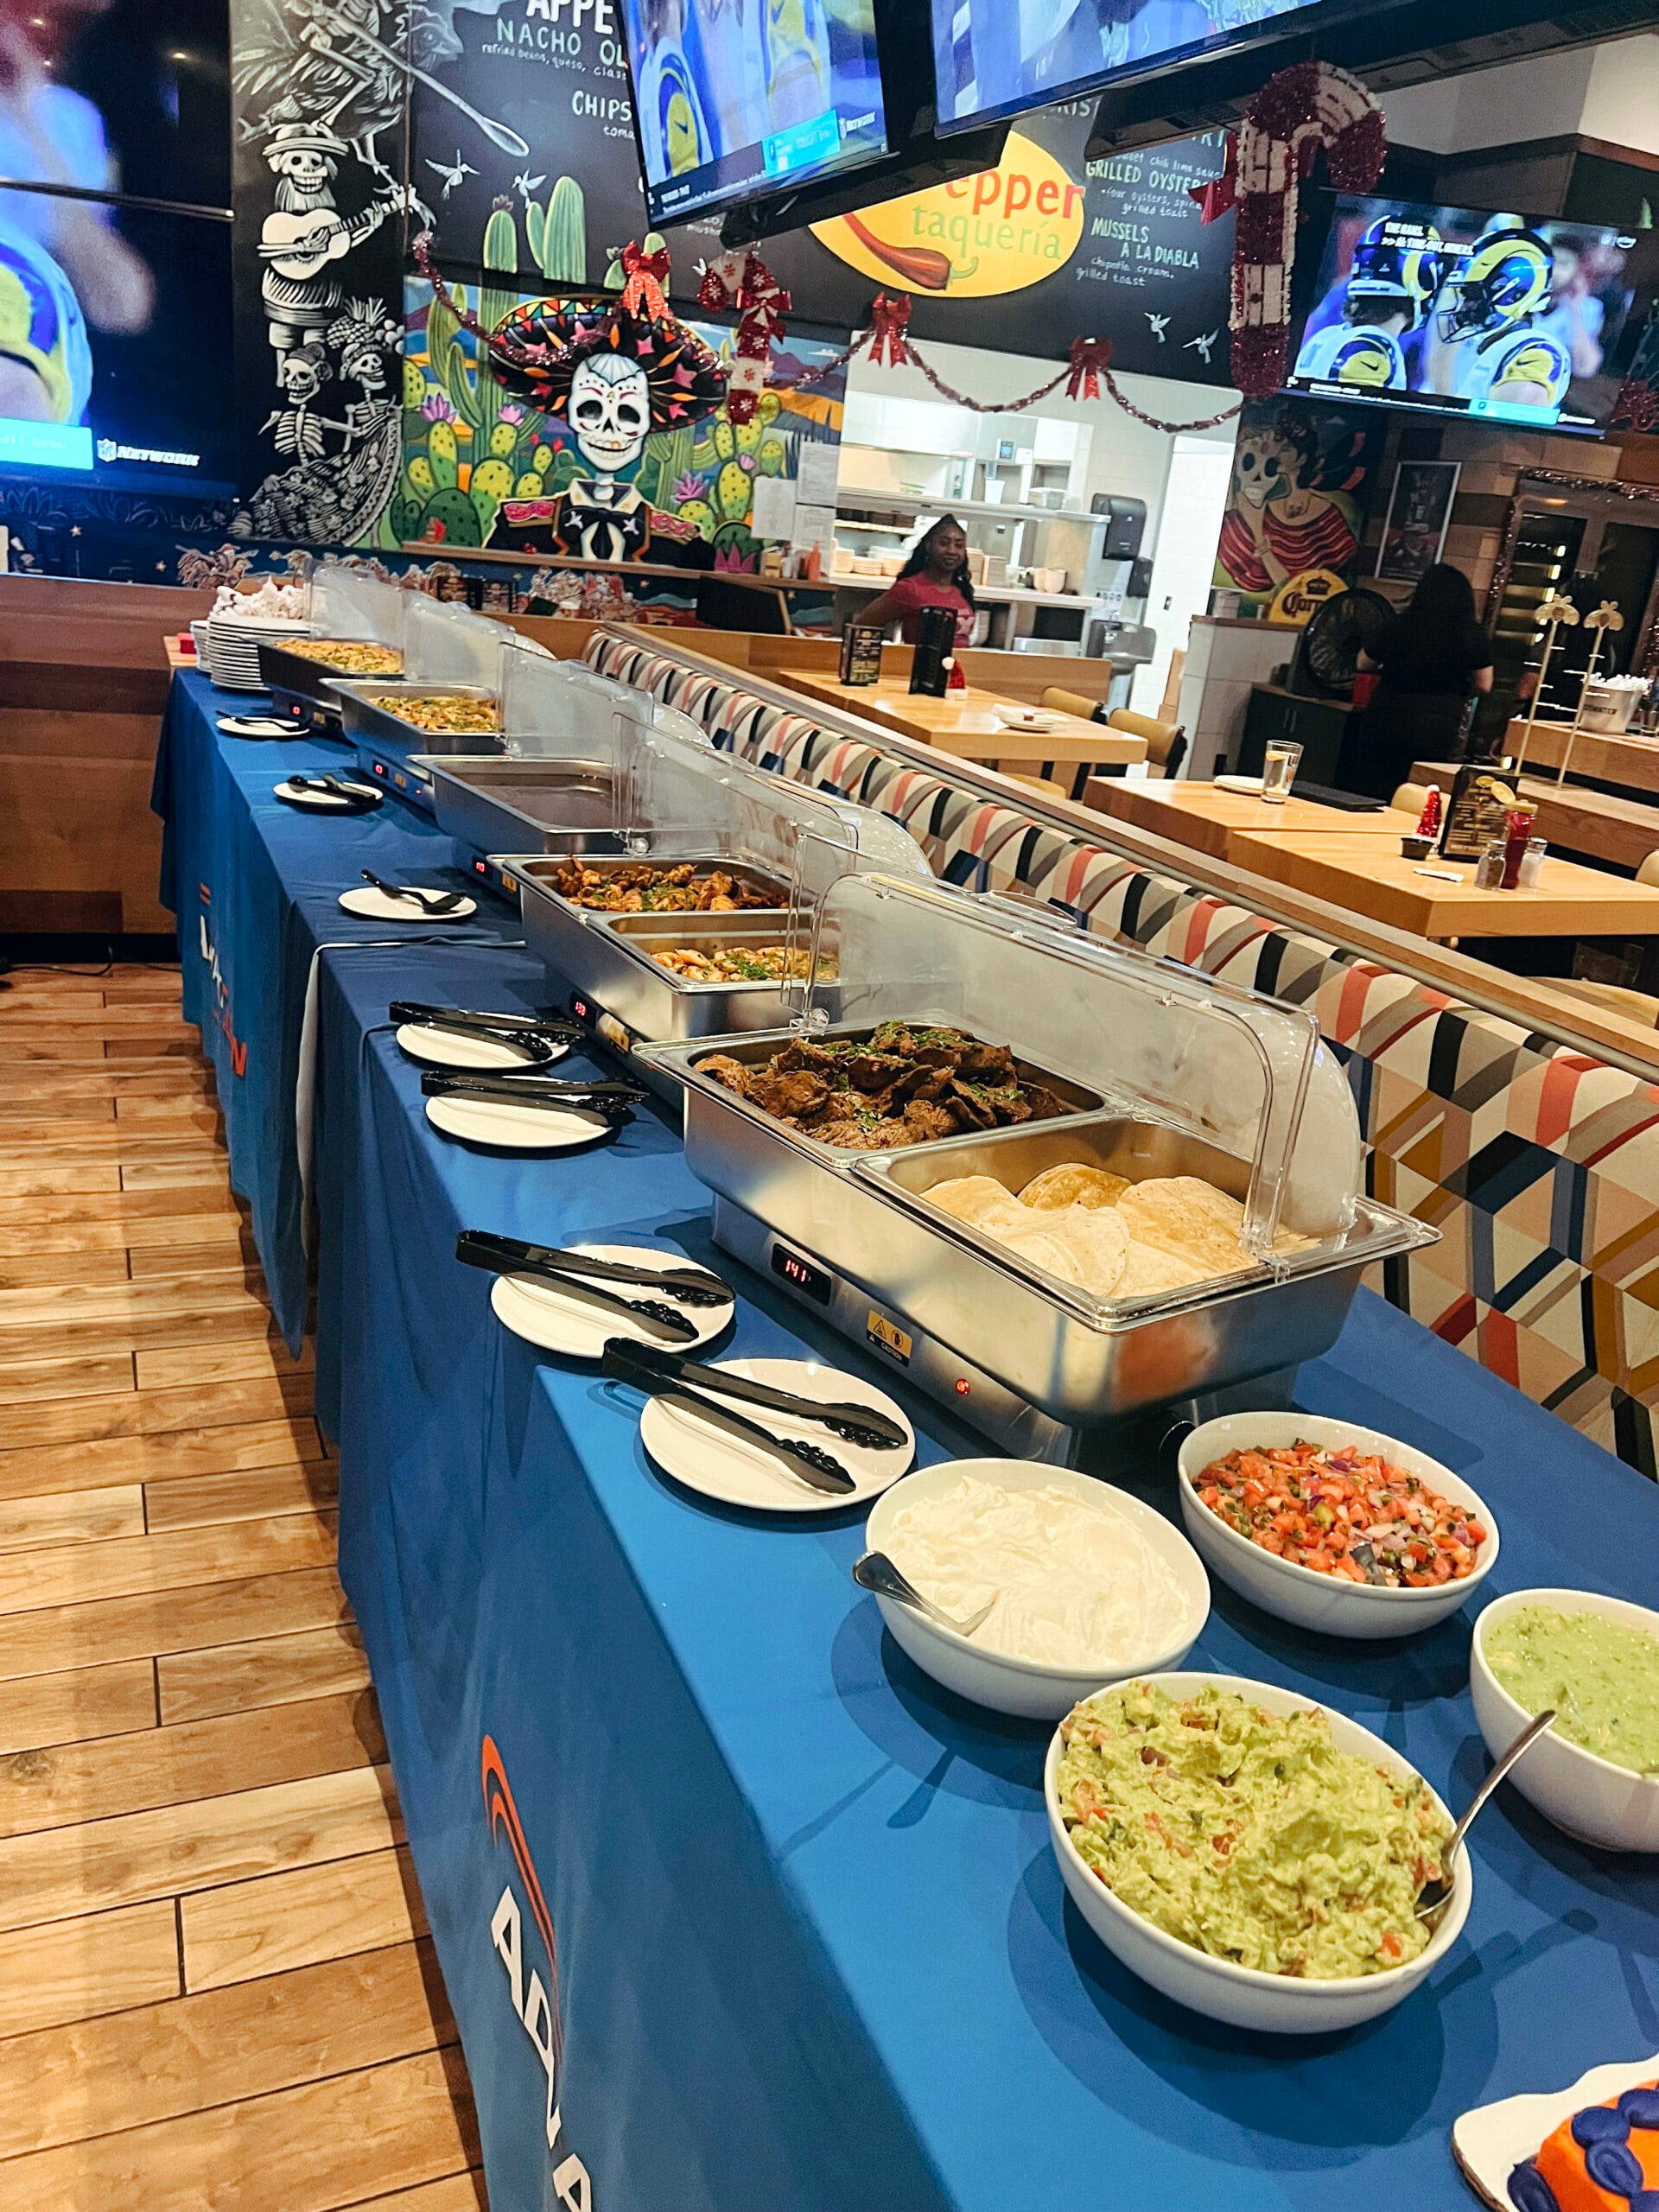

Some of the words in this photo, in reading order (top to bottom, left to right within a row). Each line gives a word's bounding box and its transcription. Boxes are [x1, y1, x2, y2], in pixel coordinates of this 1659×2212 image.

[497, 17, 582, 55] NACHO
[482, 44, 515, 57] refried
[518, 49, 550, 64] beans,
[552, 56, 586, 72] queso,
[571, 90, 632, 122] CHIPS
[1085, 161, 1141, 183] GRILLED
[1173, 161, 1192, 173] lime
[1122, 202, 1156, 215] grilled
[912, 205, 1061, 259] taquería
[1090, 218, 1150, 243] MUSSELS
[1091, 256, 1130, 271] chipotle
[1121, 242, 1130, 257] A
[1136, 244, 1152, 260] LA
[1154, 245, 1199, 270] DIABLA
[1076, 267, 1108, 281] grilled
[1113, 275, 1146, 286] toast
[785, 1260, 807, 1282] 141
[880, 1342, 902, 1362] CAUTION
